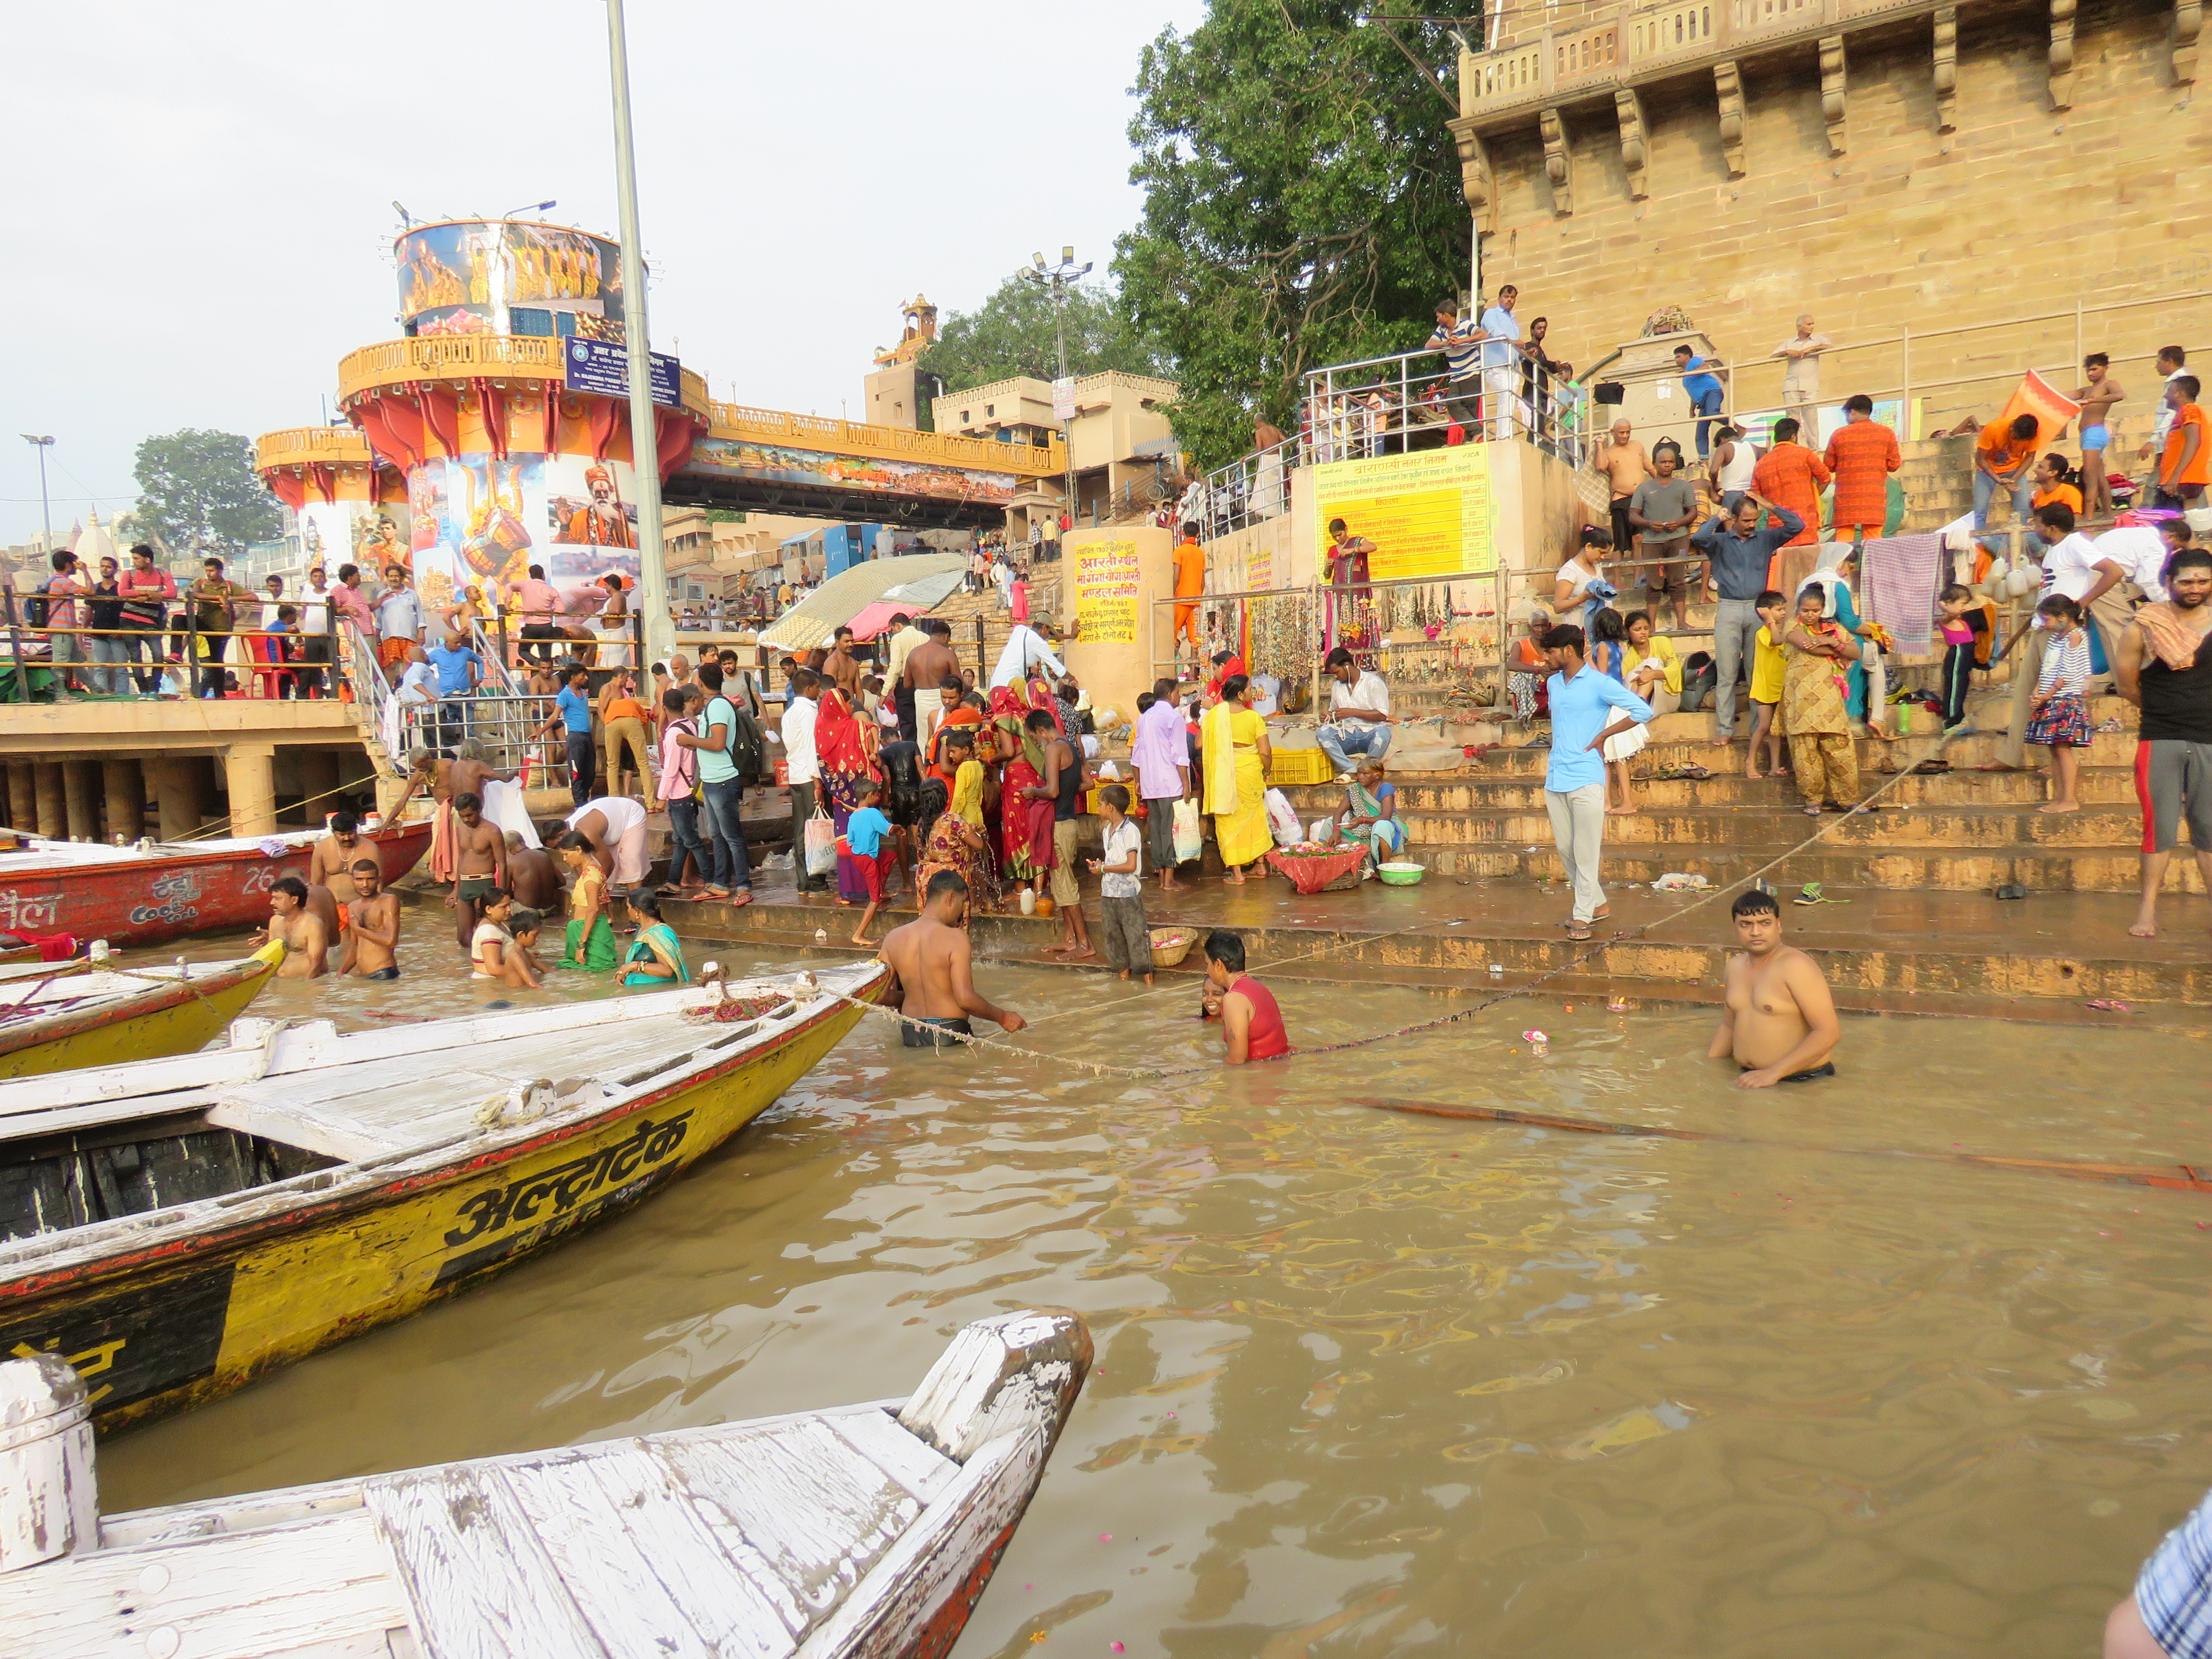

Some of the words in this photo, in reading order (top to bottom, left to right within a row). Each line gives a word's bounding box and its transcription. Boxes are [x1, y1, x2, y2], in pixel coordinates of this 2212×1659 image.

[1354, 458, 1401, 474] वाराणसी
[1401, 457, 1422, 468] नगर
[1424, 454, 1448, 466] निगम
[1375, 497, 1400, 507] विवरण
[1079, 552, 1117, 569] आरती
[1118, 556, 1139, 568] स्थल
[1250, 559, 1262, 572] आरती
[1086, 570, 1105, 584] गंगा
[1105, 569, 1121, 583] योग
[1122, 567, 1141, 583] आरती
[1082, 588, 1113, 599] मण्डल
[1113, 583, 1138, 599] समिति
[1086, 607, 1103, 620] राजेन्द्र
[1103, 609, 1119, 617] प्रसाद
[1082, 633, 1094, 642] गंगा
[1094, 630, 1101, 641] के
[1117, 631, 1127, 639] तट
[818, 843, 837, 858] WELC
[242, 866, 275, 895] 26
[444, 1108, 696, 1247] अल्ट्राटेक
